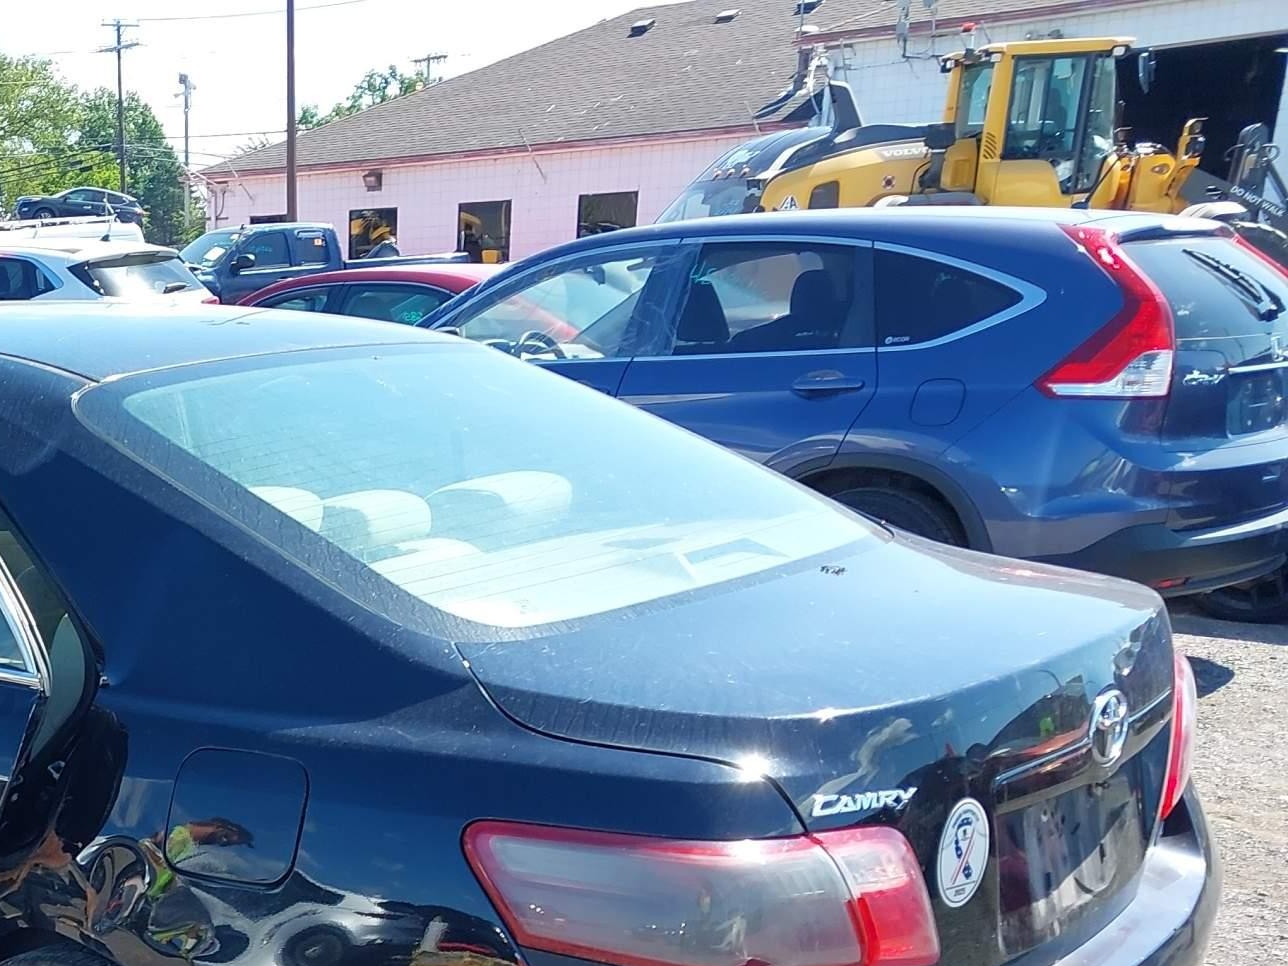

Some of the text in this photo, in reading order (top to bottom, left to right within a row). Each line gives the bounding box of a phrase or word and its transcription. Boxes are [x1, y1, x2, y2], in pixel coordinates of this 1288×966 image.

[1230, 185, 1287, 217] DO NOT WALK
[811, 787, 918, 817] CAMRY
